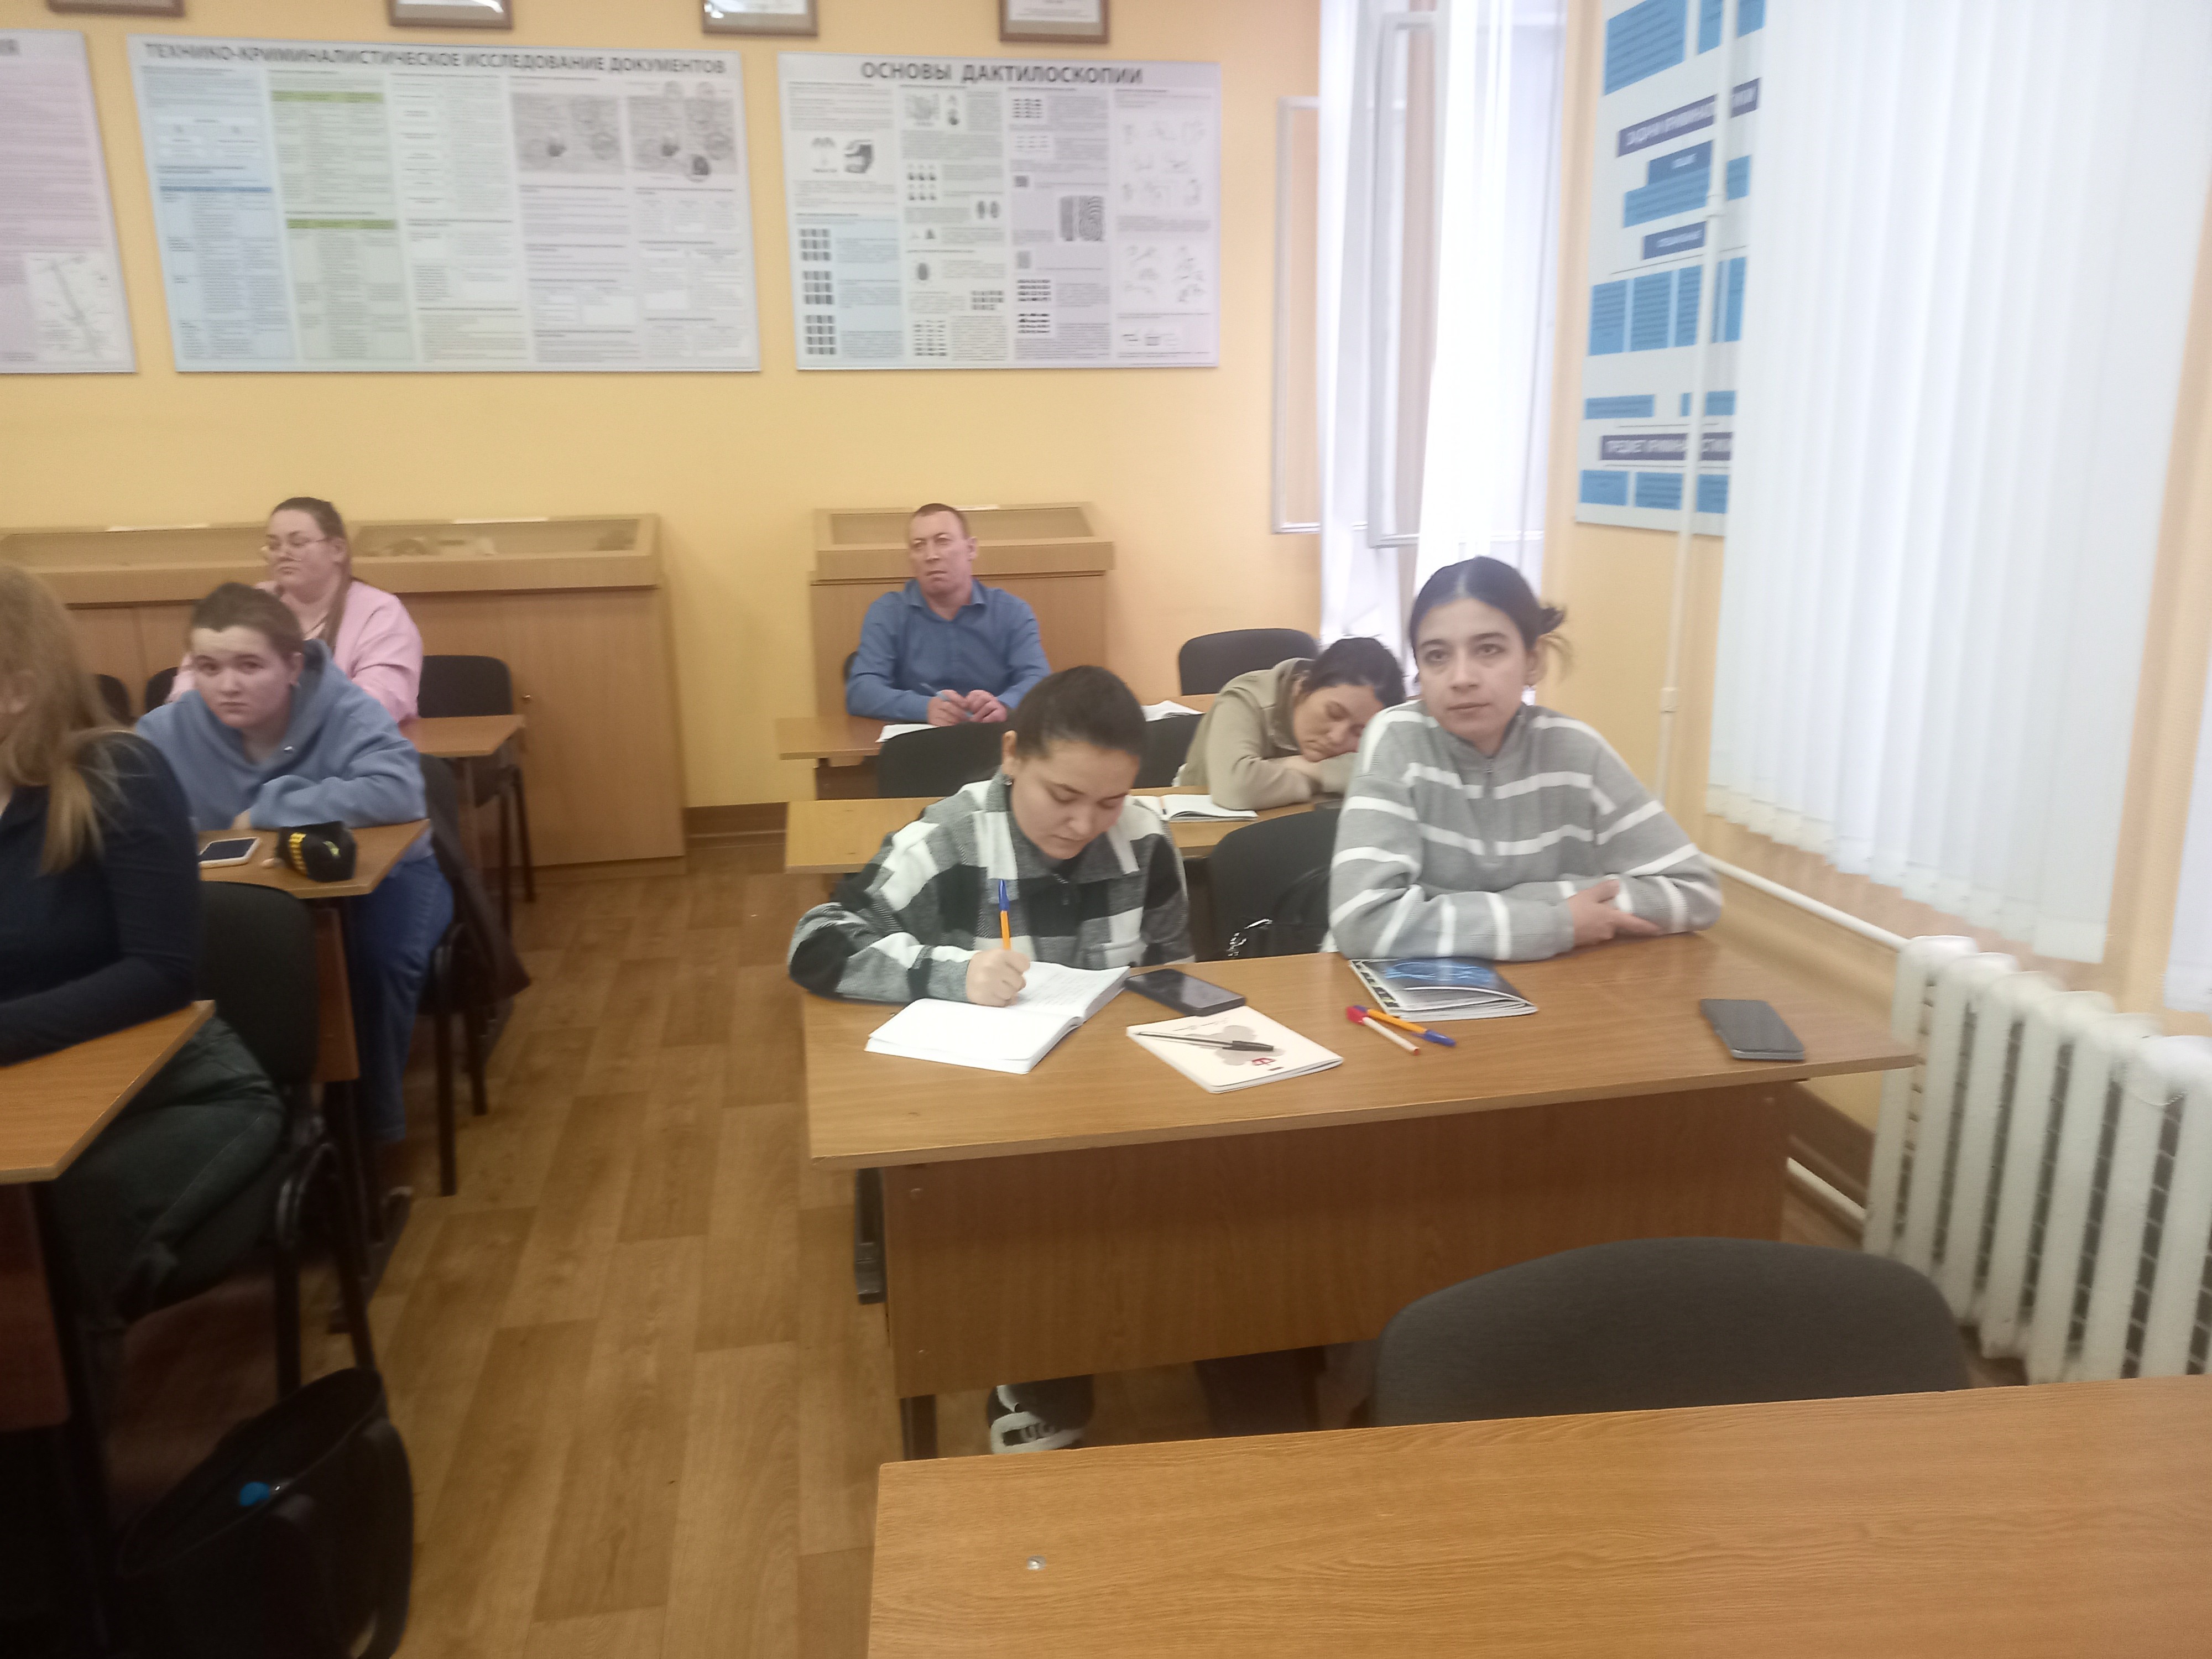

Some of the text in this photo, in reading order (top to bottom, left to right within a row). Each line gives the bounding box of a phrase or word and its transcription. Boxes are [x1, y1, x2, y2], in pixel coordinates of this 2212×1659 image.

[465, 53, 605, 72] ИССЛЕДОВАНИЕ
[608, 56, 726, 74] ДОКУМЕНТОВ
[861, 61, 1143, 84] ОСНОВЫ ДАКТИЛОСКОПИИ
